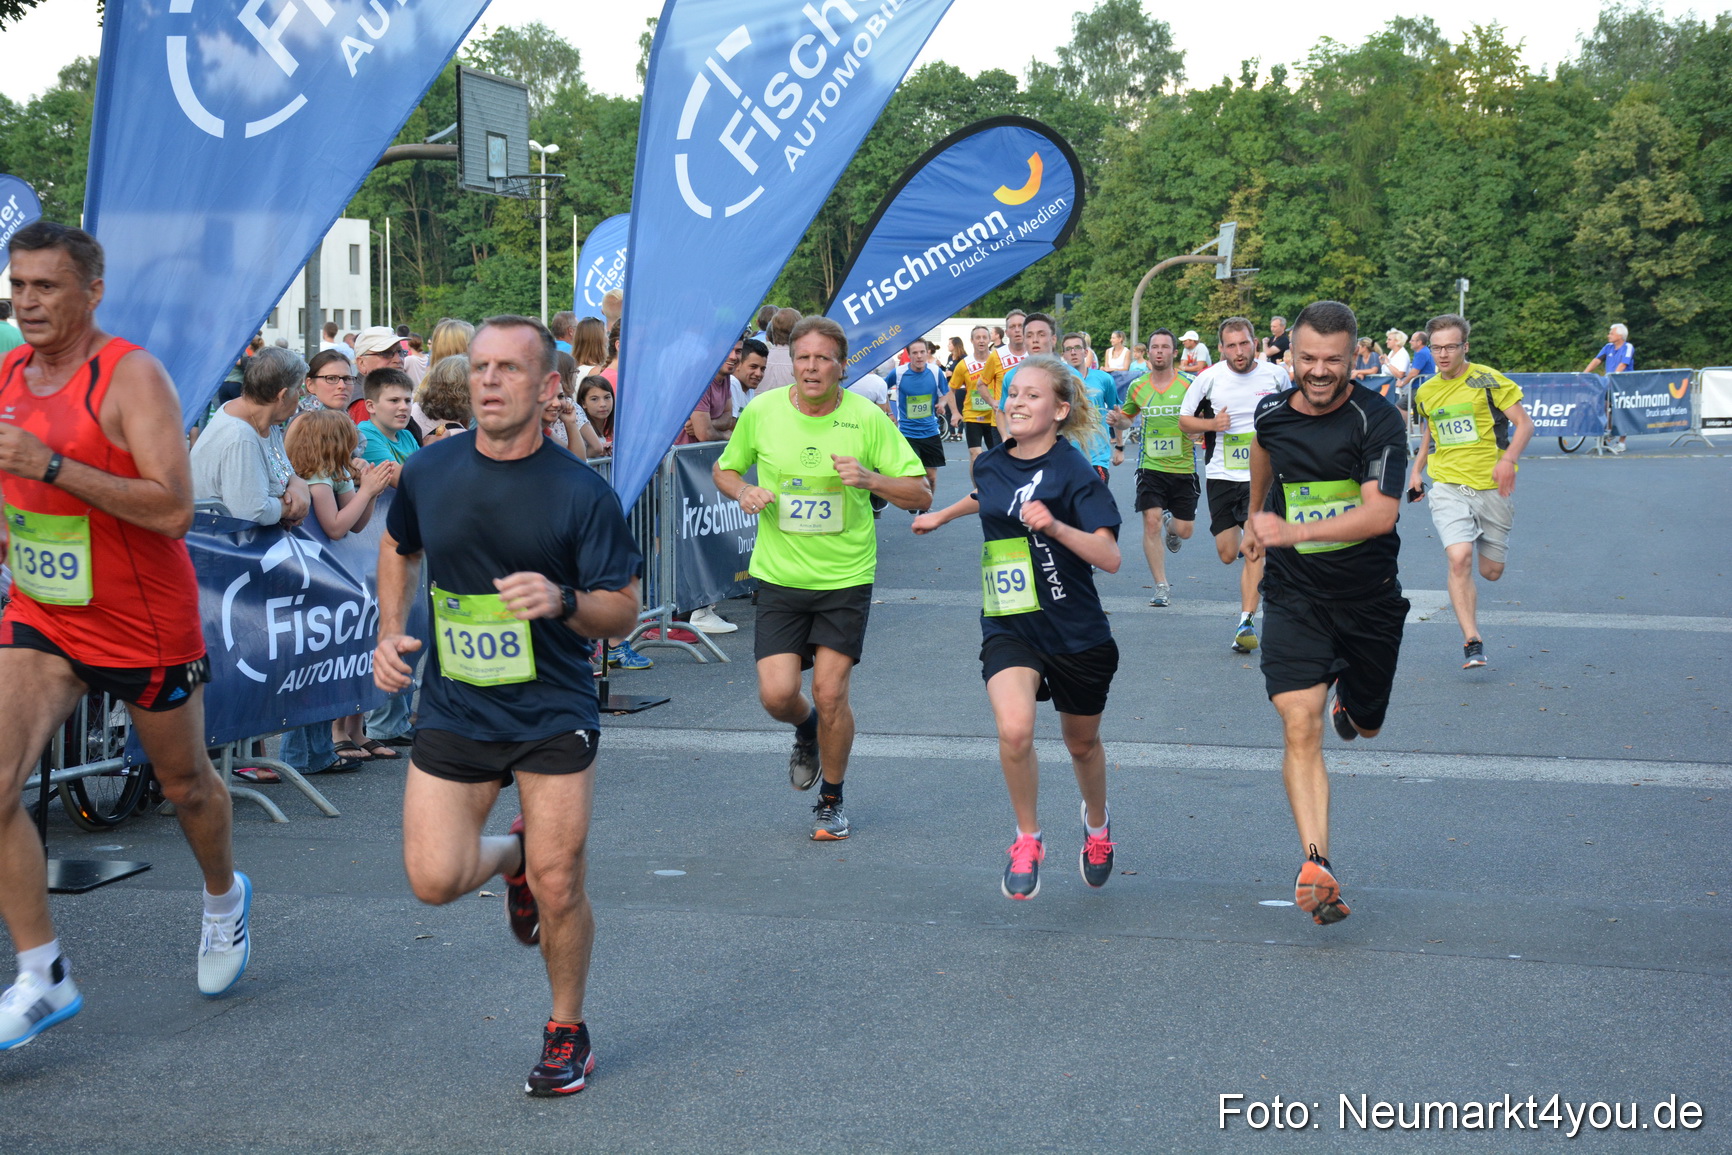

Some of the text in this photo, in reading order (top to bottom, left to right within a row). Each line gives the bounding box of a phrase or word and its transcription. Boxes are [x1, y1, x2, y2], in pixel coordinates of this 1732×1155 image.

[237, 0, 336, 78] F
[340, 0, 408, 78] AU
[718, 0, 866, 176] Fisch
[0, 194, 19, 230] er
[948, 197, 1067, 279] Druck und Medien
[842, 210, 1009, 326] Frischmann
[911, 403, 928, 413] 799
[974, 397, 988, 406] 85
[1612, 390, 1670, 410] Frischmann
[1645, 408, 1660, 418] Druck
[1438, 419, 1473, 436] 1183
[1153, 439, 1174, 451] 121
[1232, 447, 1250, 460] 40
[790, 499, 832, 520] 273
[14, 542, 79, 581] 1389
[985, 568, 1026, 596] 1159
[266, 581, 380, 662] Fisch
[444, 627, 521, 661] 1308
